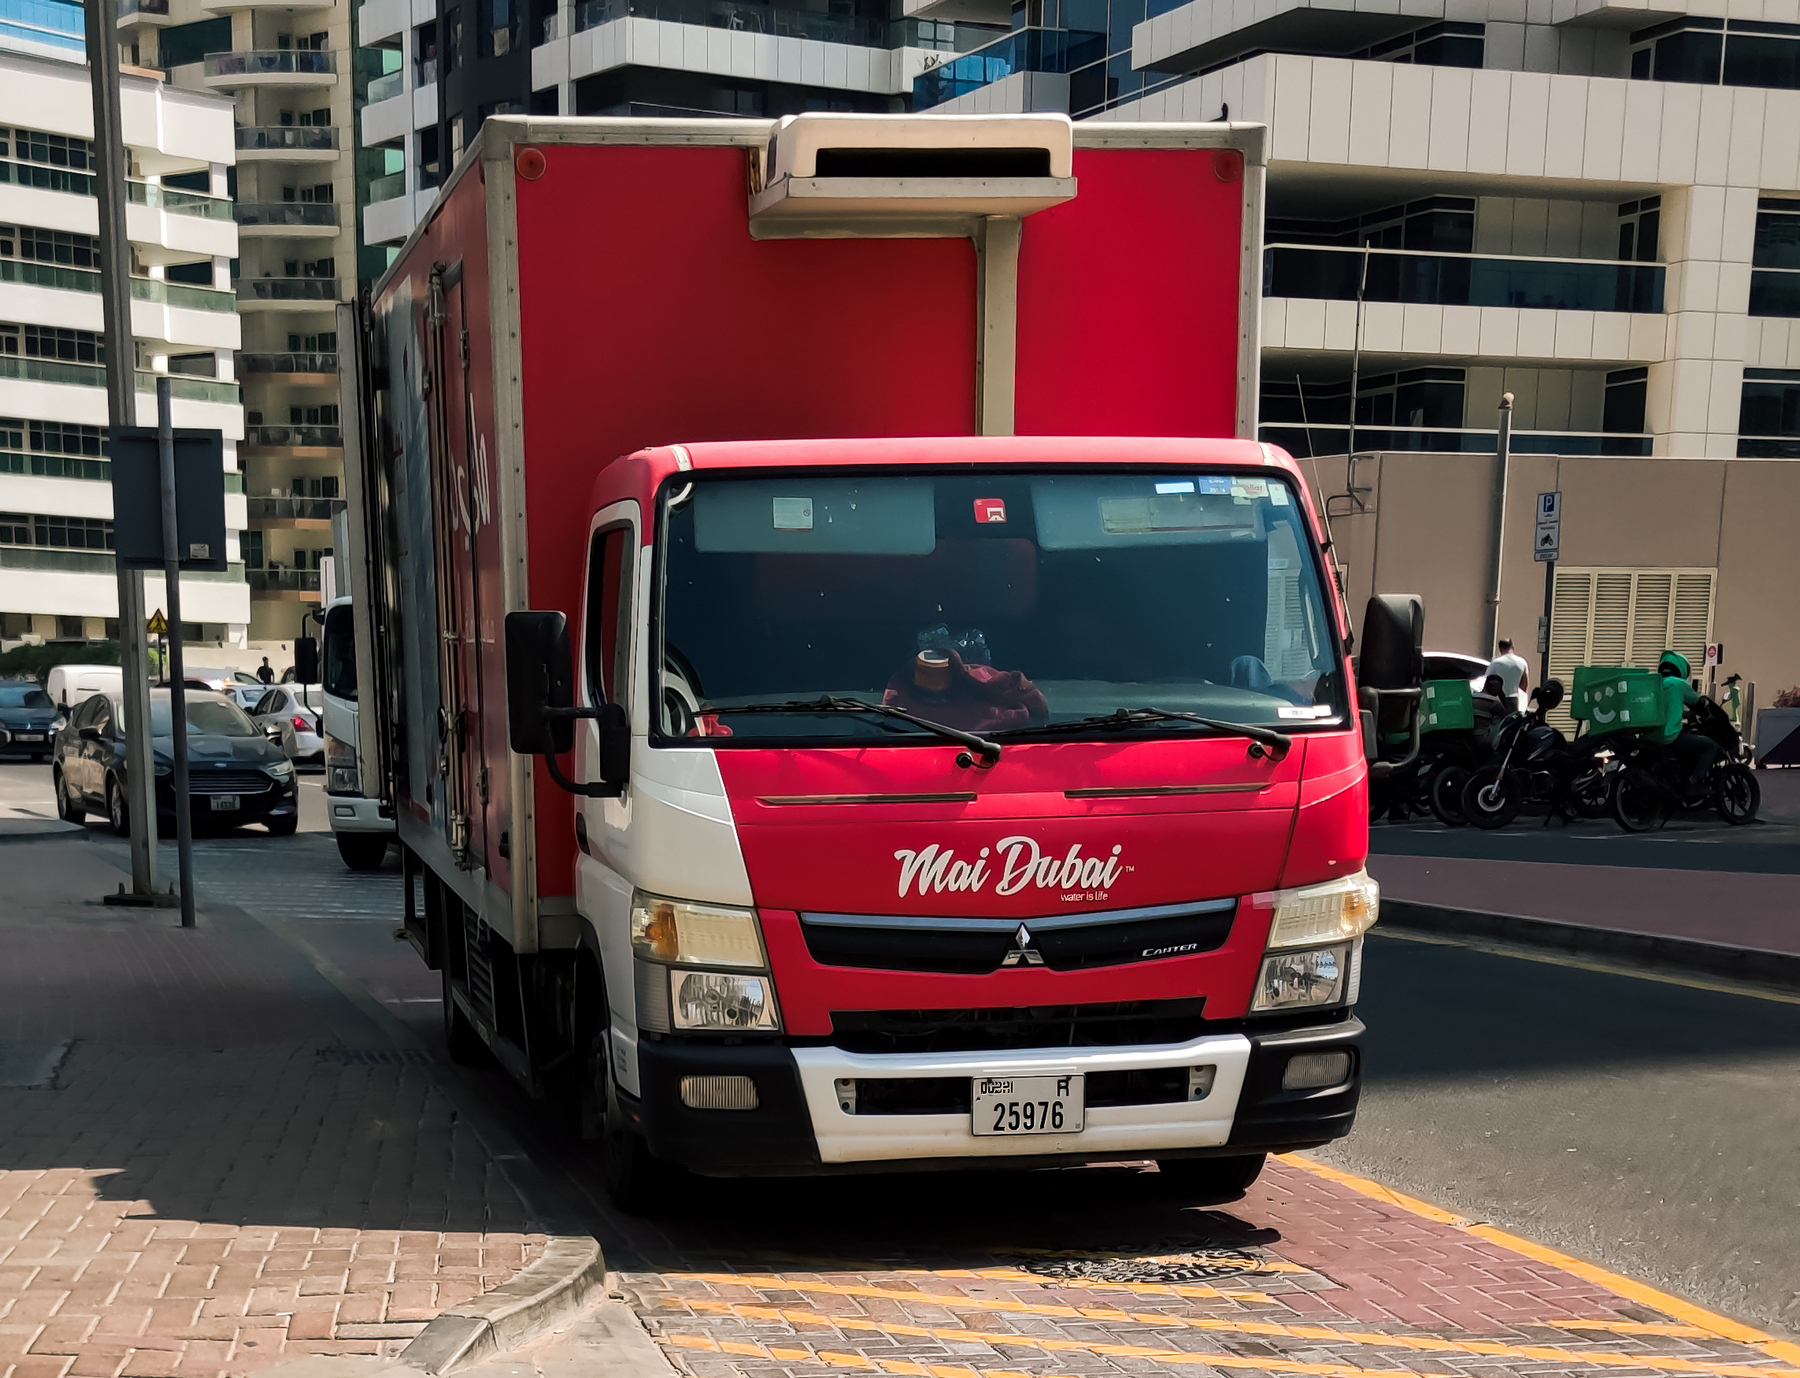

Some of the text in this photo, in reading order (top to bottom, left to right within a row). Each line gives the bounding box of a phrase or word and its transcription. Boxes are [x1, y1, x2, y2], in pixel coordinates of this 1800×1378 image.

[1545, 495, 1554, 512] P
[893, 842, 991, 898] Mai
[995, 835, 1124, 896] Dubai
[1059, 890, 1109, 902] water is life
[1141, 942, 1199, 957] CANTER
[1056, 1079, 1070, 1097] R
[992, 1101, 1064, 1132] 25976
